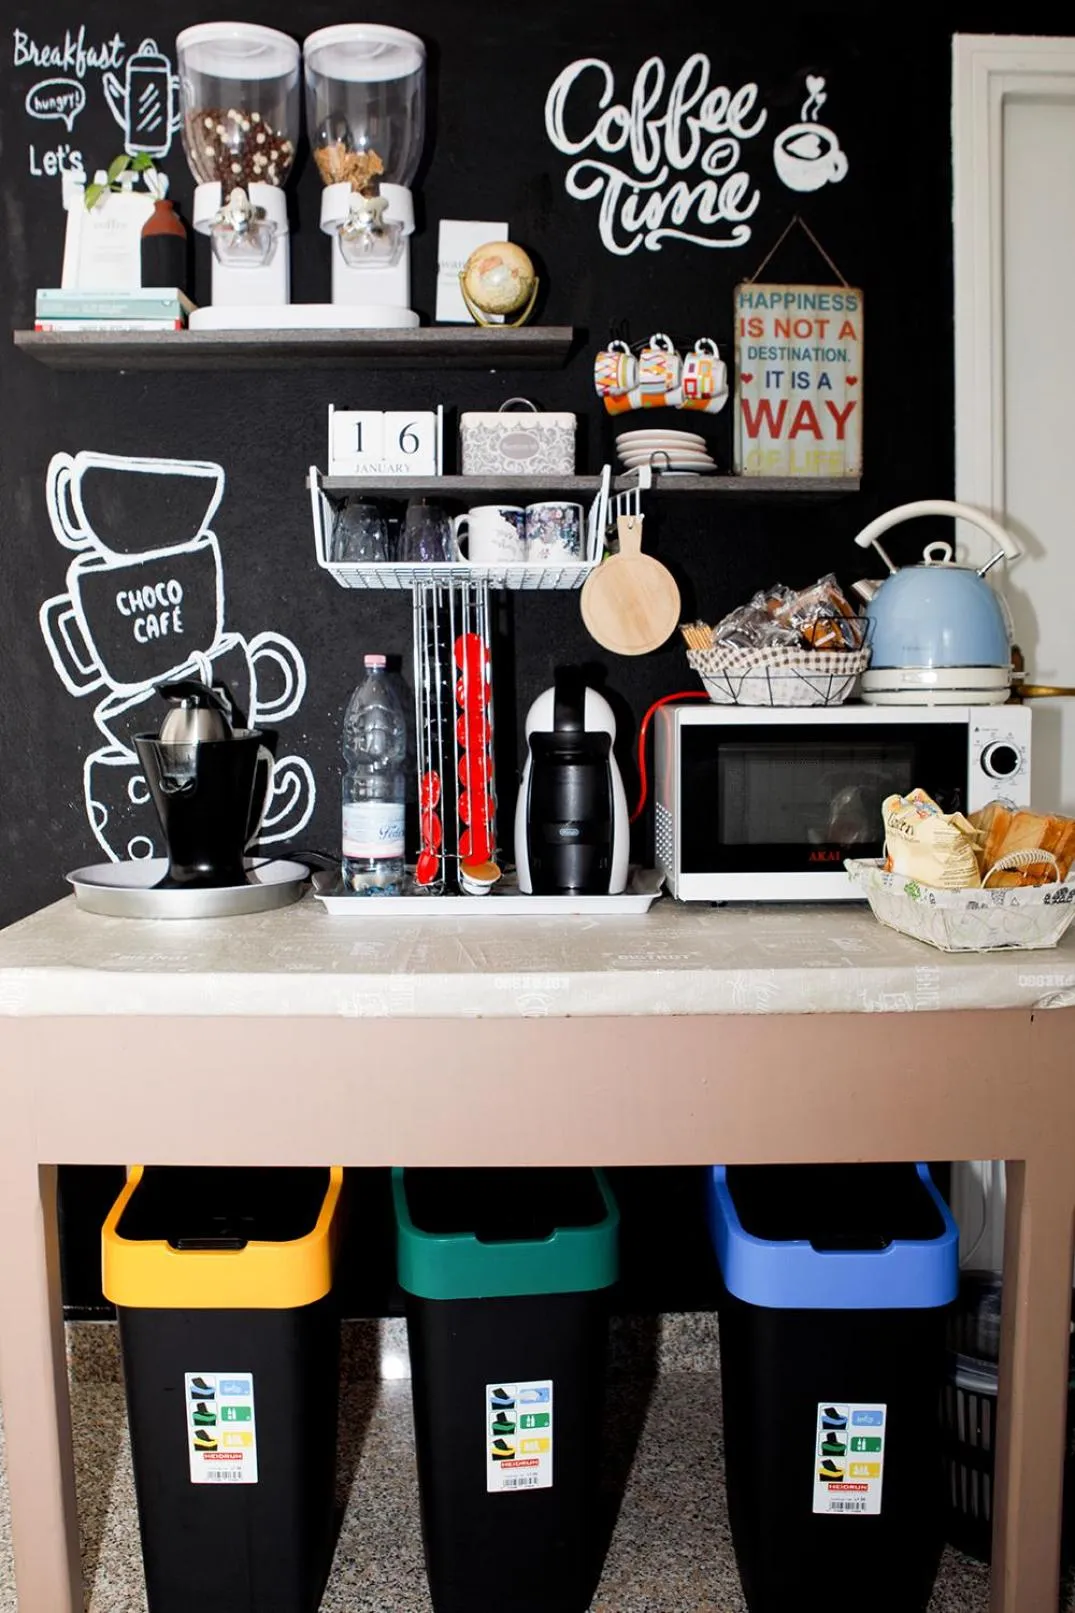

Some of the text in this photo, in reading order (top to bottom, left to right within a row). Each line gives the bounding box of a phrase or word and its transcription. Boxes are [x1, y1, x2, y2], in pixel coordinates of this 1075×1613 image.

[13, 24, 126, 78] Breakfast
[34, 90, 81, 112] hungry!
[545, 52, 767, 174] Coffee
[29, 144, 84, 176] Let's
[565, 159, 760, 256] Time
[739, 292, 858, 312] HAPPINESS
[740, 318, 857, 341] IS NOT A
[765, 370, 832, 390] IT IS A
[740, 398, 857, 440] WAY
[355, 463, 412, 474] JANUARY
[746, 449, 845, 474] OF LIFE
[116, 579, 183, 616] CHOCO
[809, 851, 841, 861] AKAI
